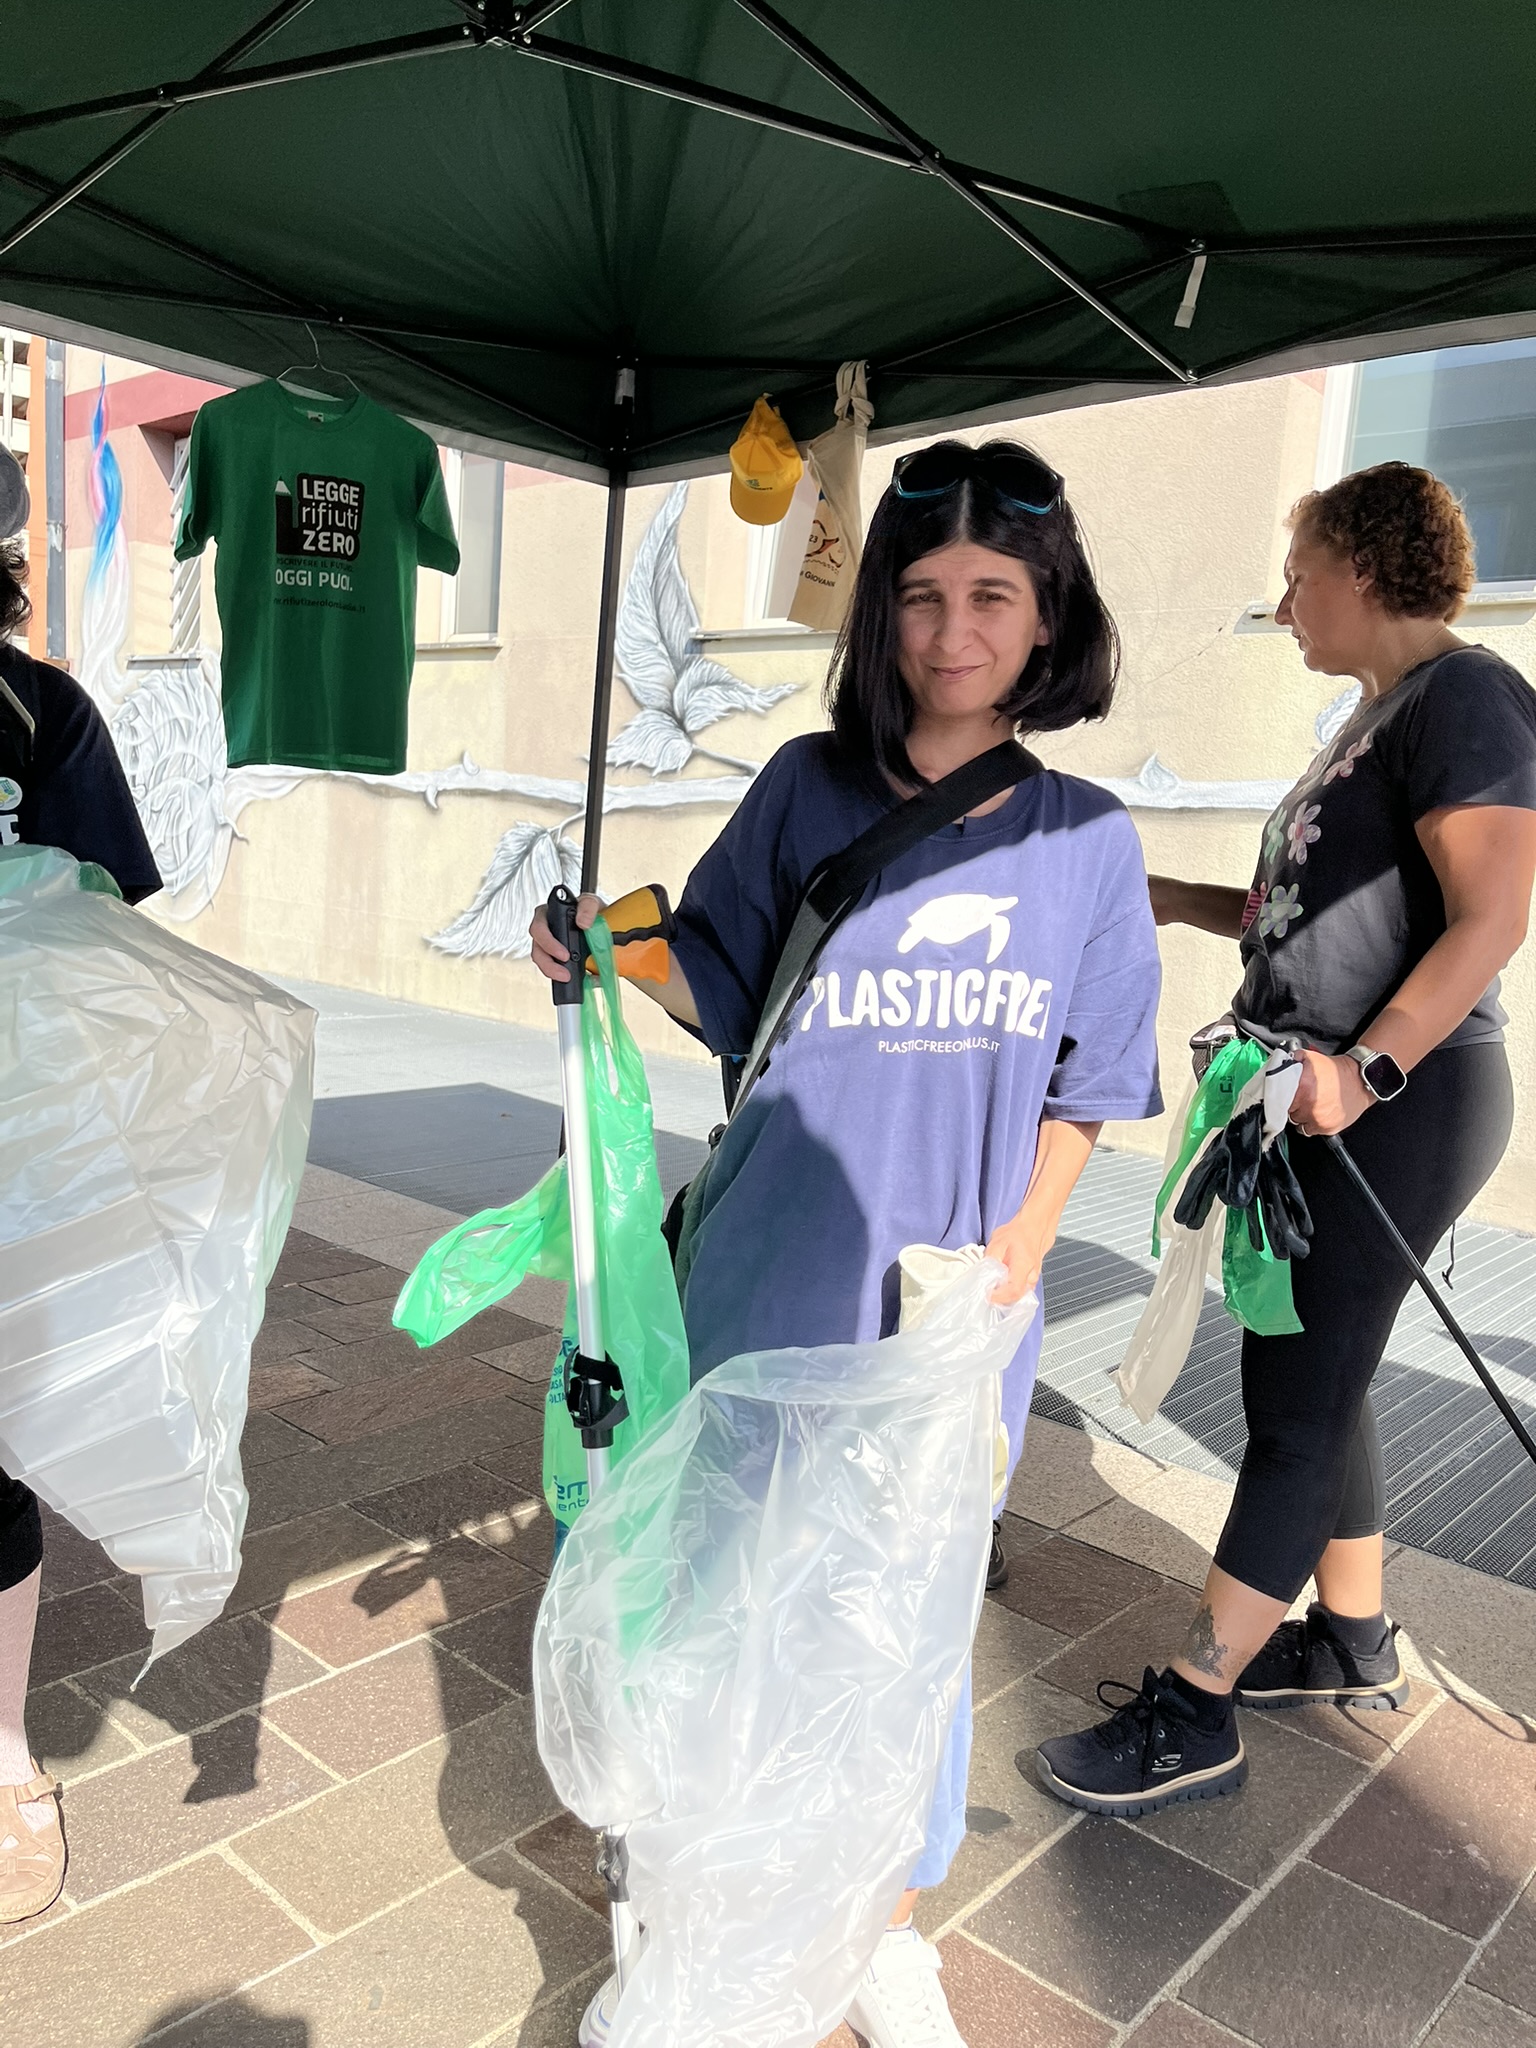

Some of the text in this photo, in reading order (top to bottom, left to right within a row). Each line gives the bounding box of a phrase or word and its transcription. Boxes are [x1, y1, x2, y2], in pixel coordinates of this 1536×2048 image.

[302, 478, 360, 507] LEGGE
[302, 502, 359, 531] rifiuti
[302, 529, 355, 556] ZERO
[275, 568, 312, 587] OGGI
[878, 1037, 1000, 1054] PLASTICFREEONLUS.IT
